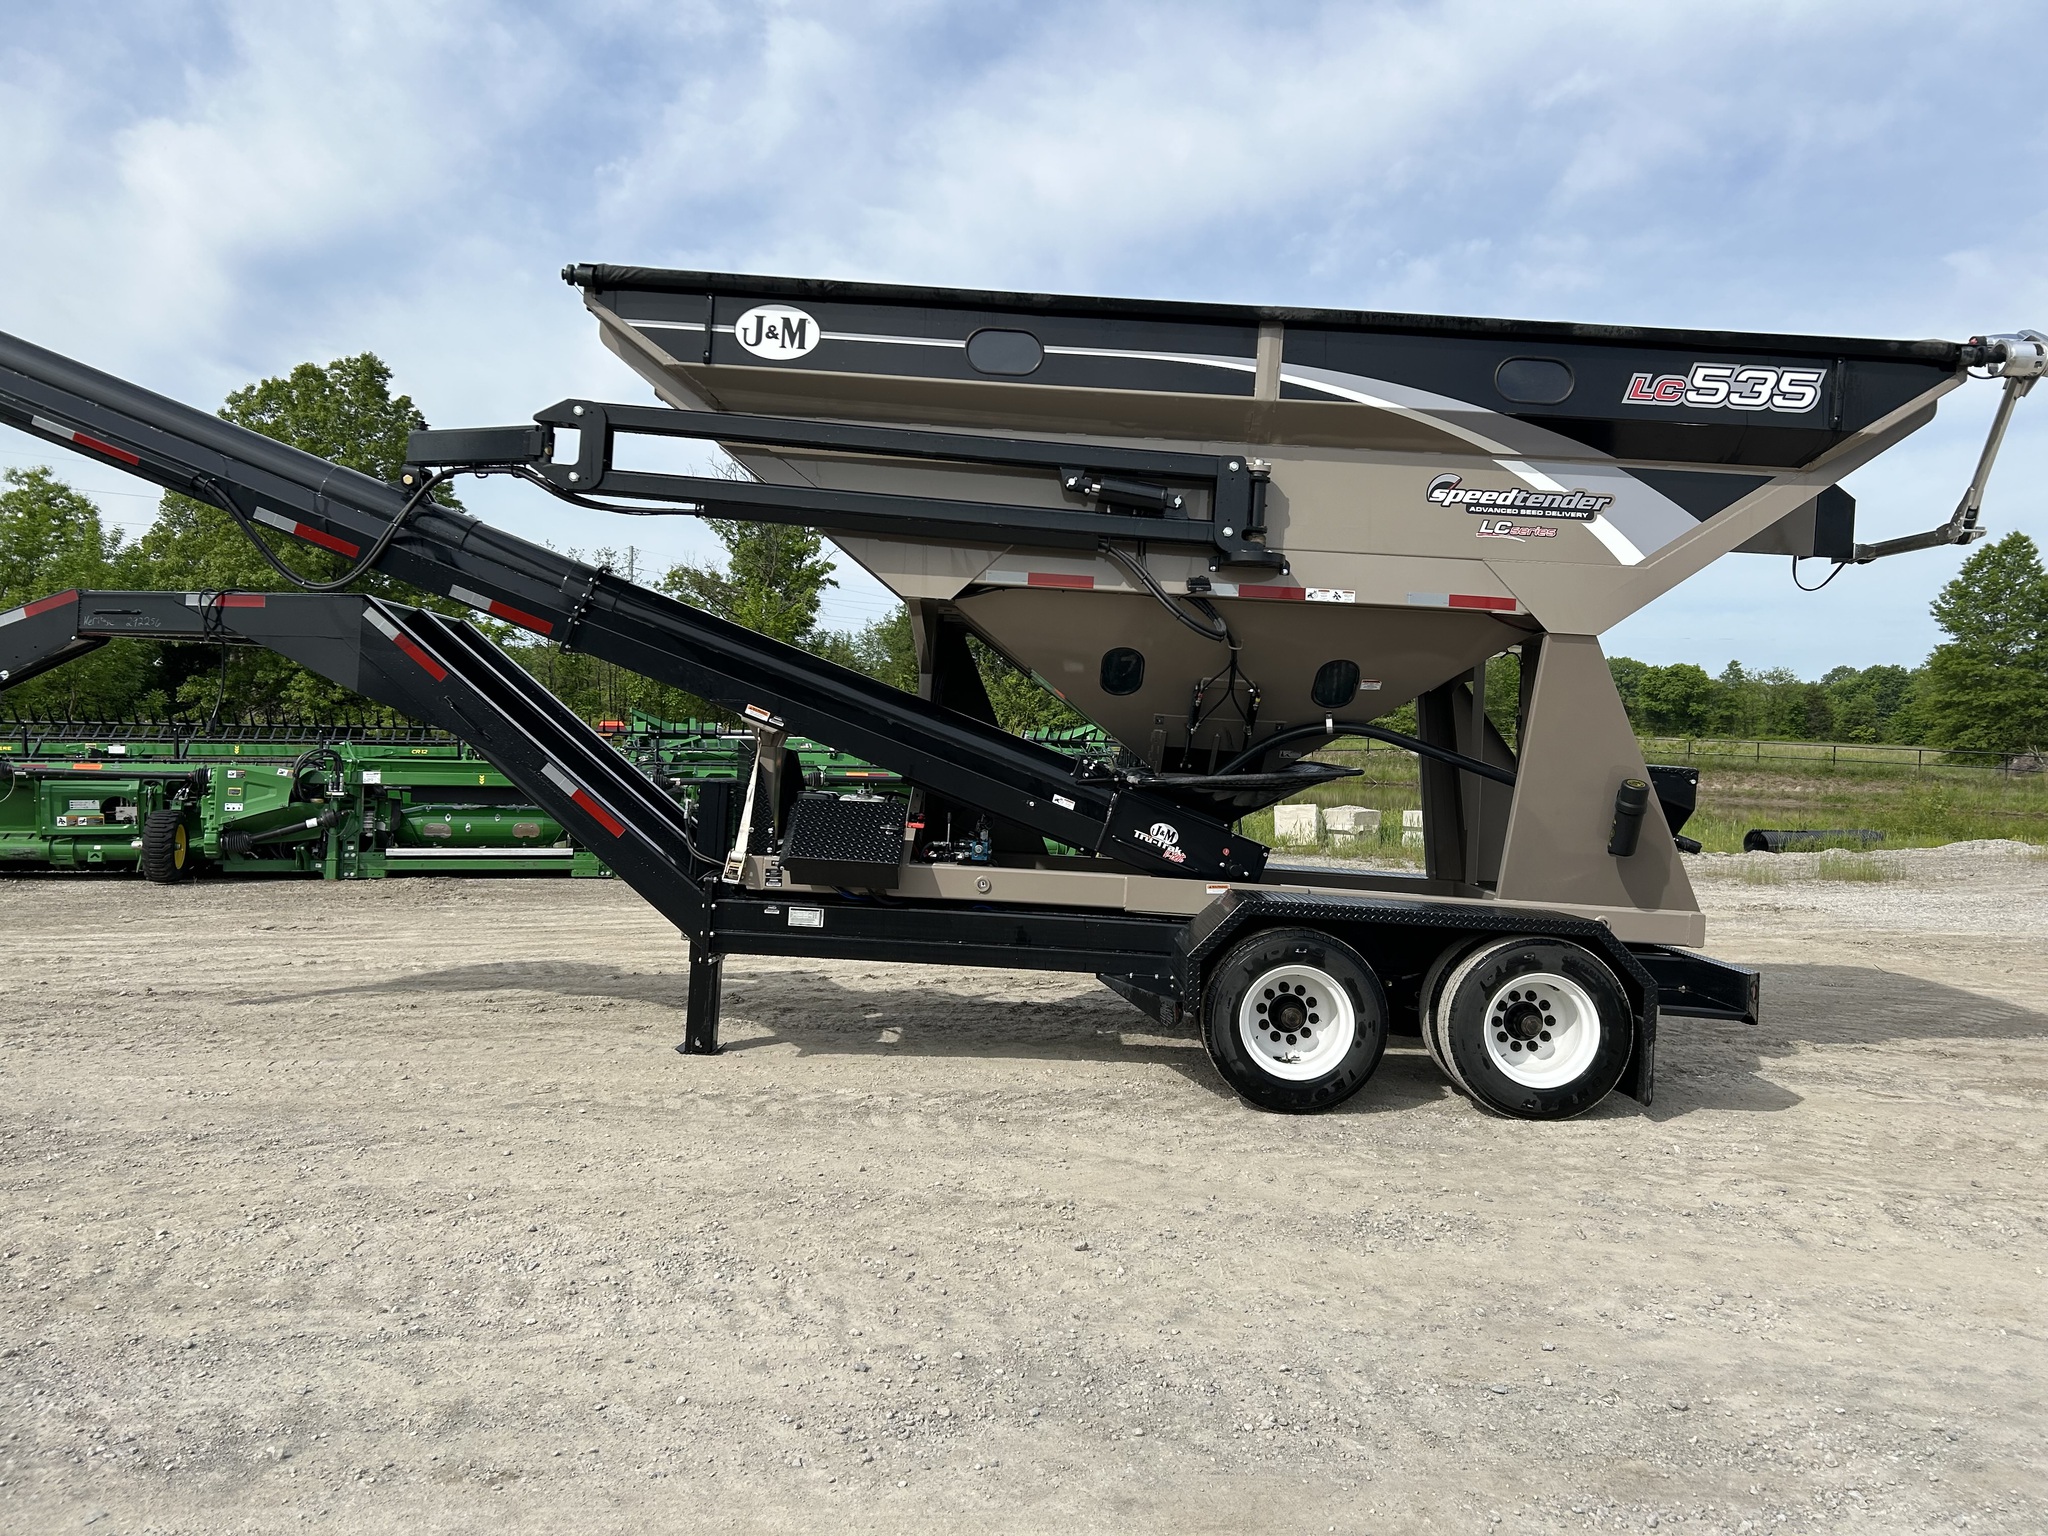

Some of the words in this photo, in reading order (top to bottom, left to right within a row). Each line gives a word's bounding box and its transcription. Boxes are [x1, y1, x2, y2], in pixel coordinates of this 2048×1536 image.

[742, 315, 809, 350] J&M
[1469, 506, 1518, 515] ADVANCED
[1520, 508, 1544, 516] SEED
[1545, 510, 1589, 519] DELIVERY
[1133, 829, 1182, 854] Tru-Trak
[1151, 825, 1177, 844] J&M
